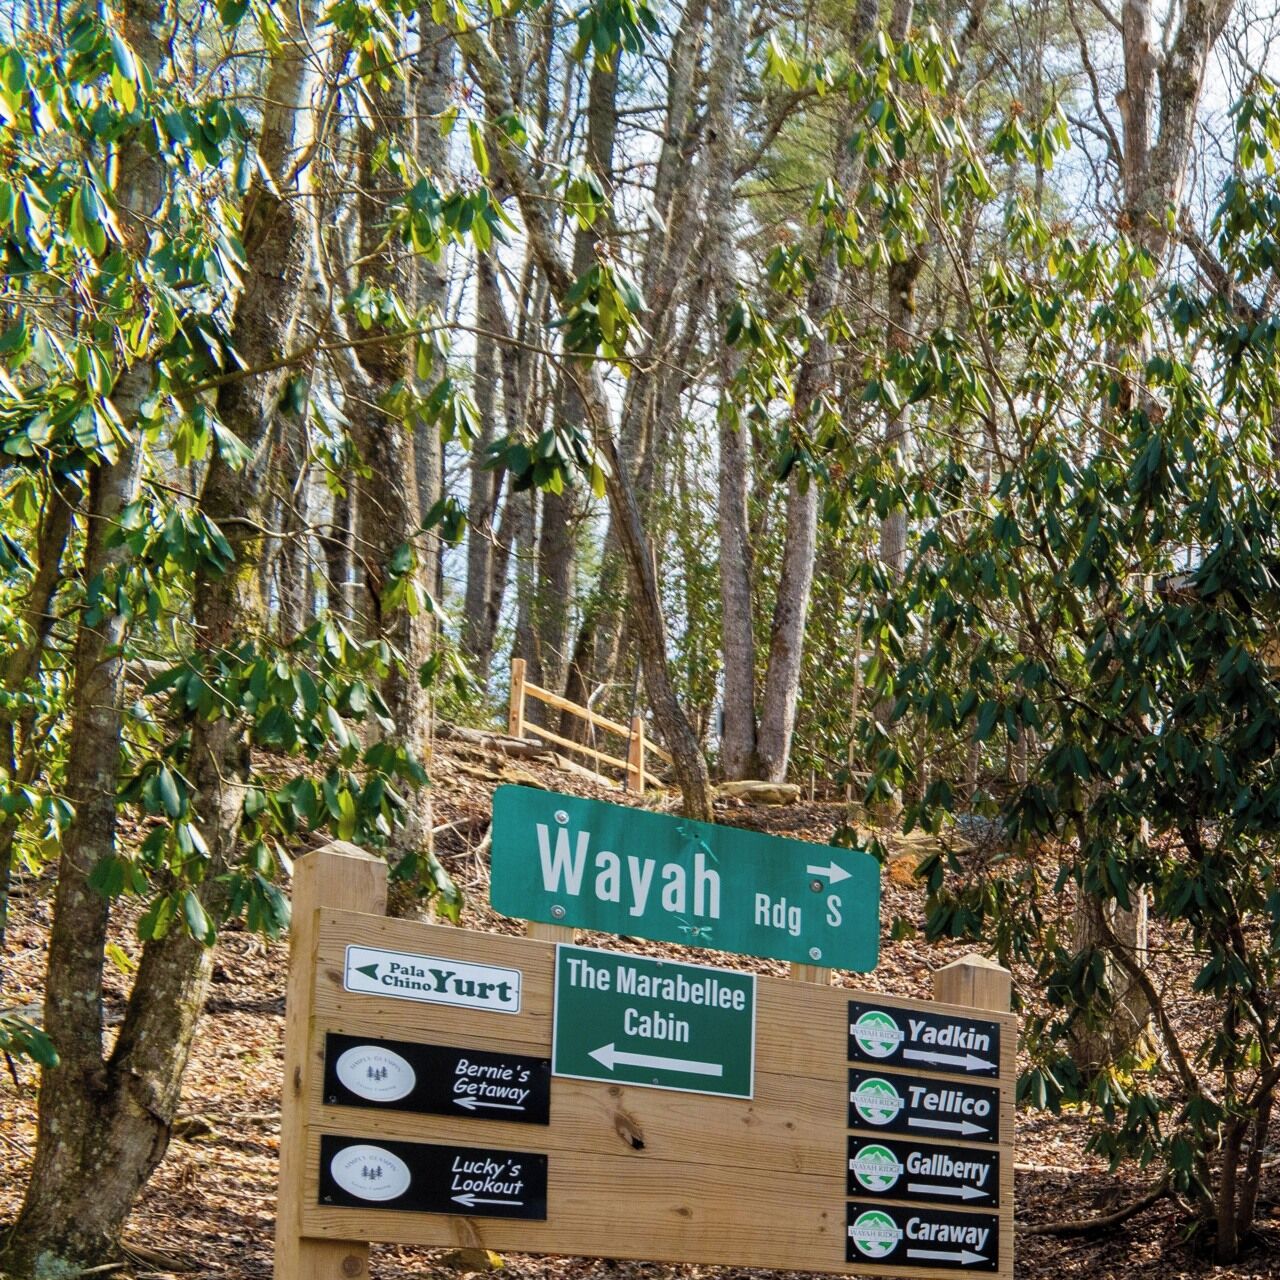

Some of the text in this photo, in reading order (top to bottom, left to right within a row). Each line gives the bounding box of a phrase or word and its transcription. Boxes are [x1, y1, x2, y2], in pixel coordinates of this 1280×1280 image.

[536, 822, 842, 937] Wayah Rdg S
[381, 974, 431, 992] Chino
[389, 962, 425, 978] Pala
[428, 968, 512, 1002] Yurt
[567, 958, 745, 1012] The Marabellee
[624, 1007, 689, 1043] Cabin
[908, 1019, 990, 1051] Yadkin
[455, 1058, 531, 1083] Bernie's
[453, 1077, 530, 1104] Getaway
[908, 1085, 990, 1117] Tellico
[451, 1156, 521, 1180] Lucky's
[906, 1151, 990, 1187] Gallberry
[451, 1175, 523, 1195] Lookout
[905, 1217, 989, 1251] Caraway
